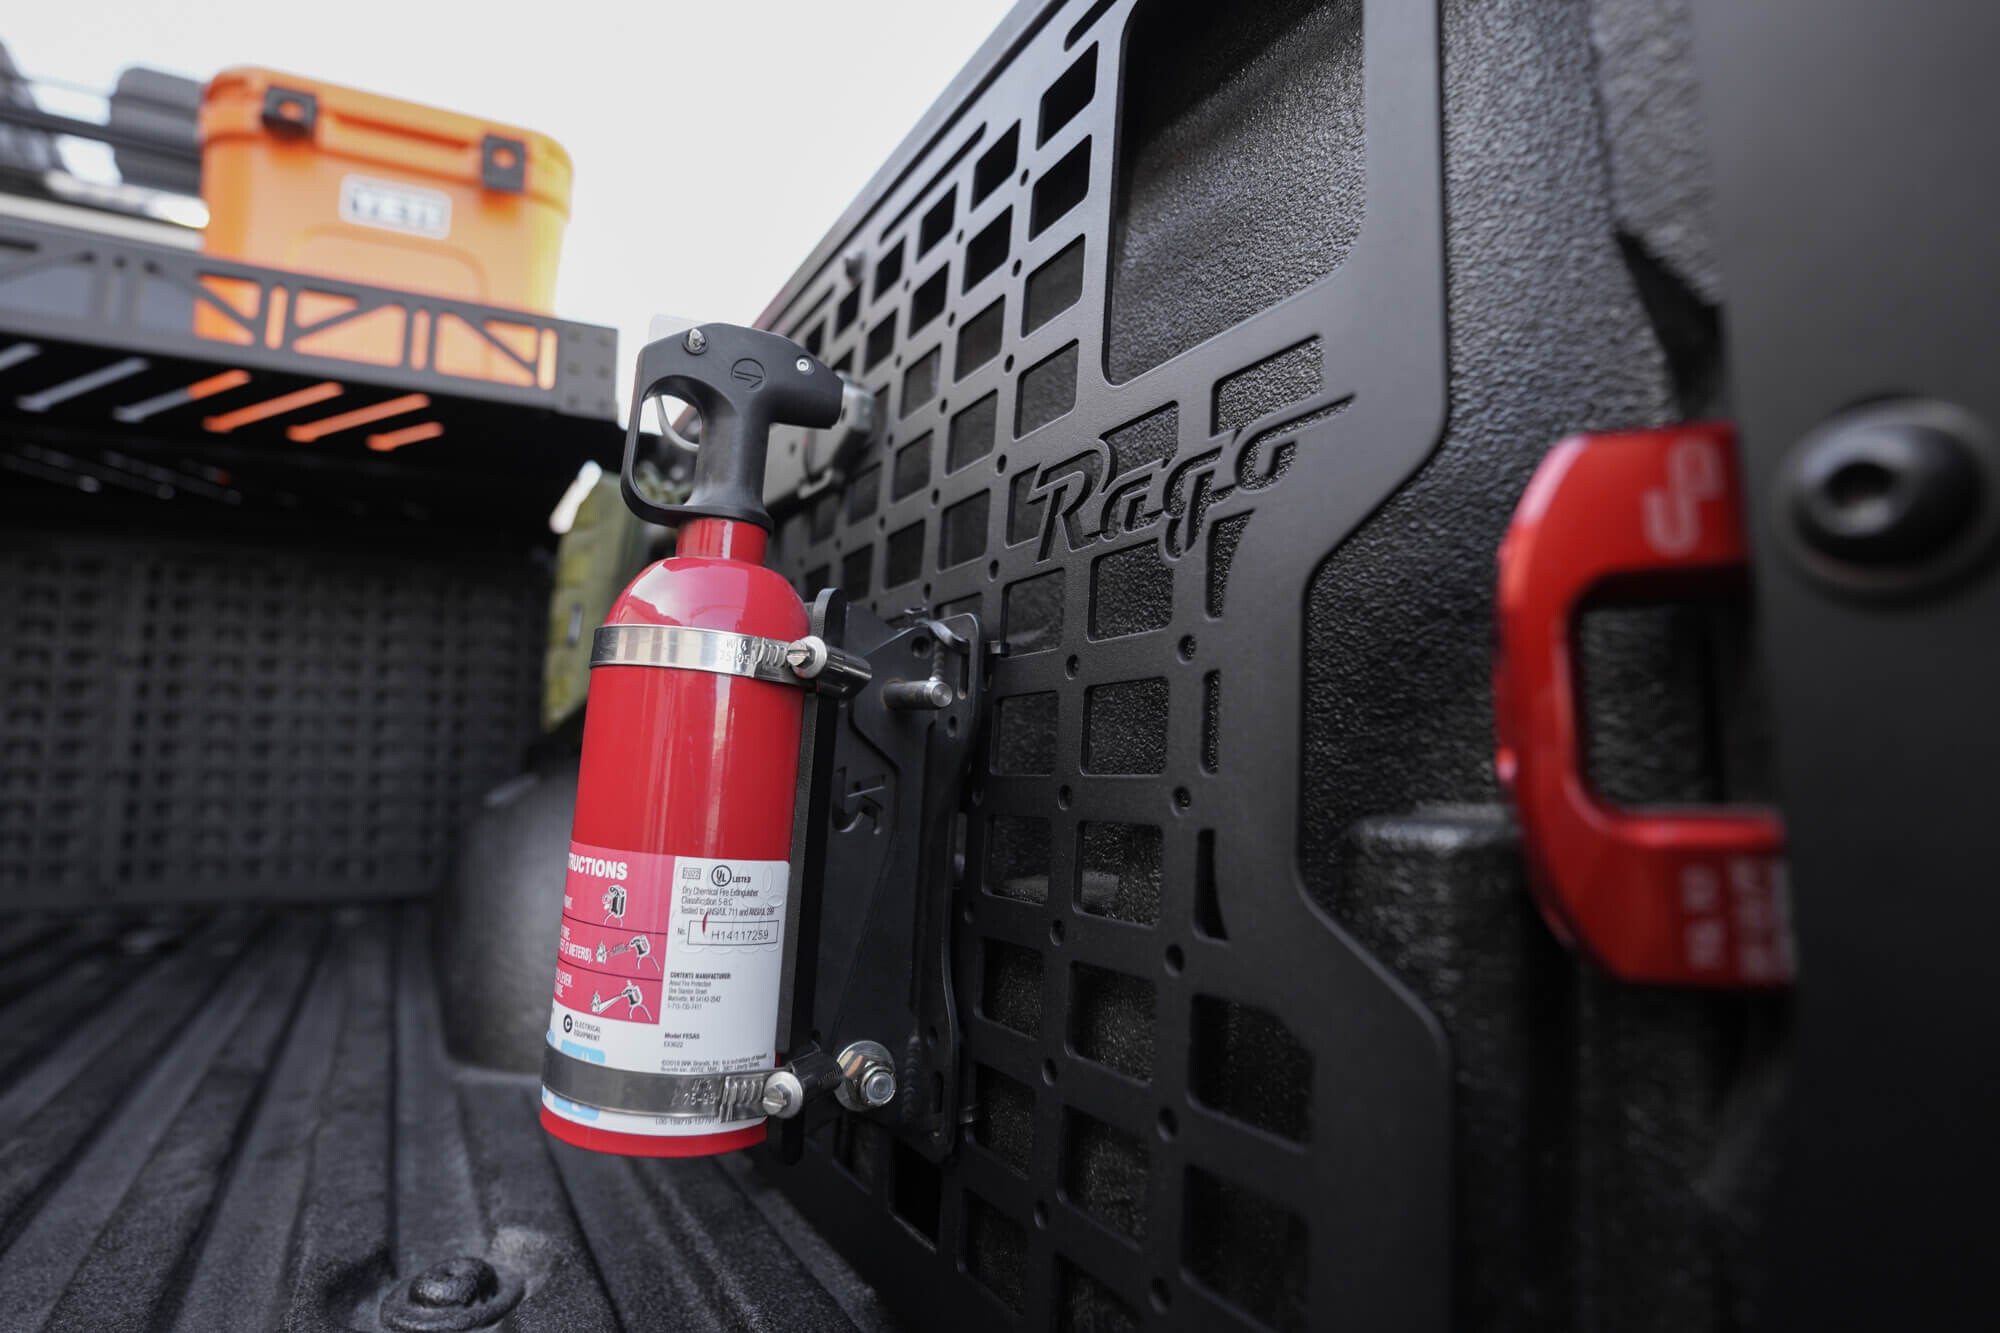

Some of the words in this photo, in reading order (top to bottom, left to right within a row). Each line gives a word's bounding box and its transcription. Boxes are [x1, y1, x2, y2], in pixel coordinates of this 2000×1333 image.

[1025, 393, 1354, 565] Rago
[683, 886, 692, 896] Dry
[693, 887, 718, 896] Chemical
[720, 888, 729, 896] Fire
[730, 889, 759, 899] Extinguisher
[682, 906, 699, 915] Tested
[729, 908, 738, 916] 711
[739, 909, 748, 917] and
[712, 929, 769, 941] H14117259
[665, 1032, 682, 1040] Model
